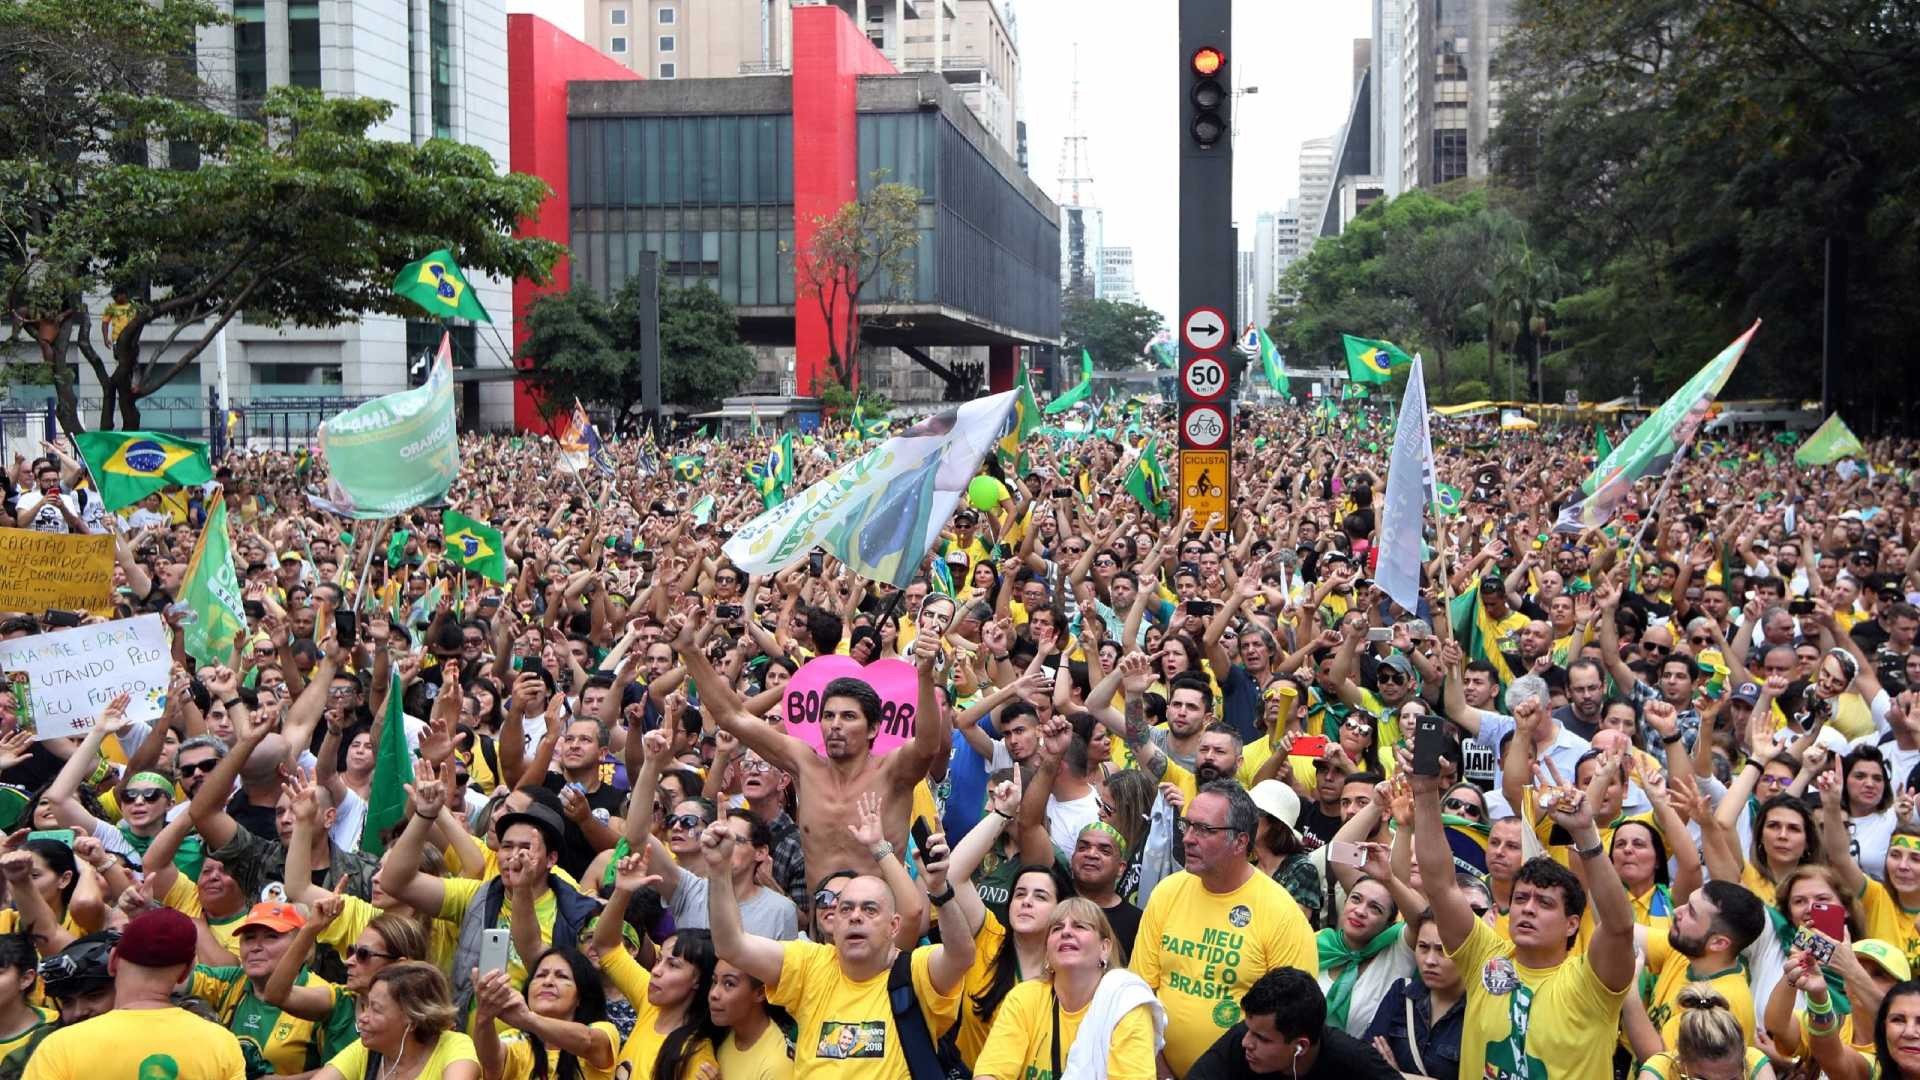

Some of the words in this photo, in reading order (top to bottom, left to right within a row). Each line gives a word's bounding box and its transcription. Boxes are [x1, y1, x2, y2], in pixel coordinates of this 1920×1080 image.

[1192, 365, 1220, 386] 50
[1184, 455, 1226, 465] CICLISTA
[82, 639, 92, 652] E
[127, 646, 160, 667] PELO
[33, 695, 72, 717] MEU
[1202, 927, 1244, 950] MEU
[1161, 934, 1241, 968] PARTIDO
[1169, 971, 1234, 1000] BRASIL
[1222, 968, 1238, 985] O
[864, 1042, 883, 1051] 2018
